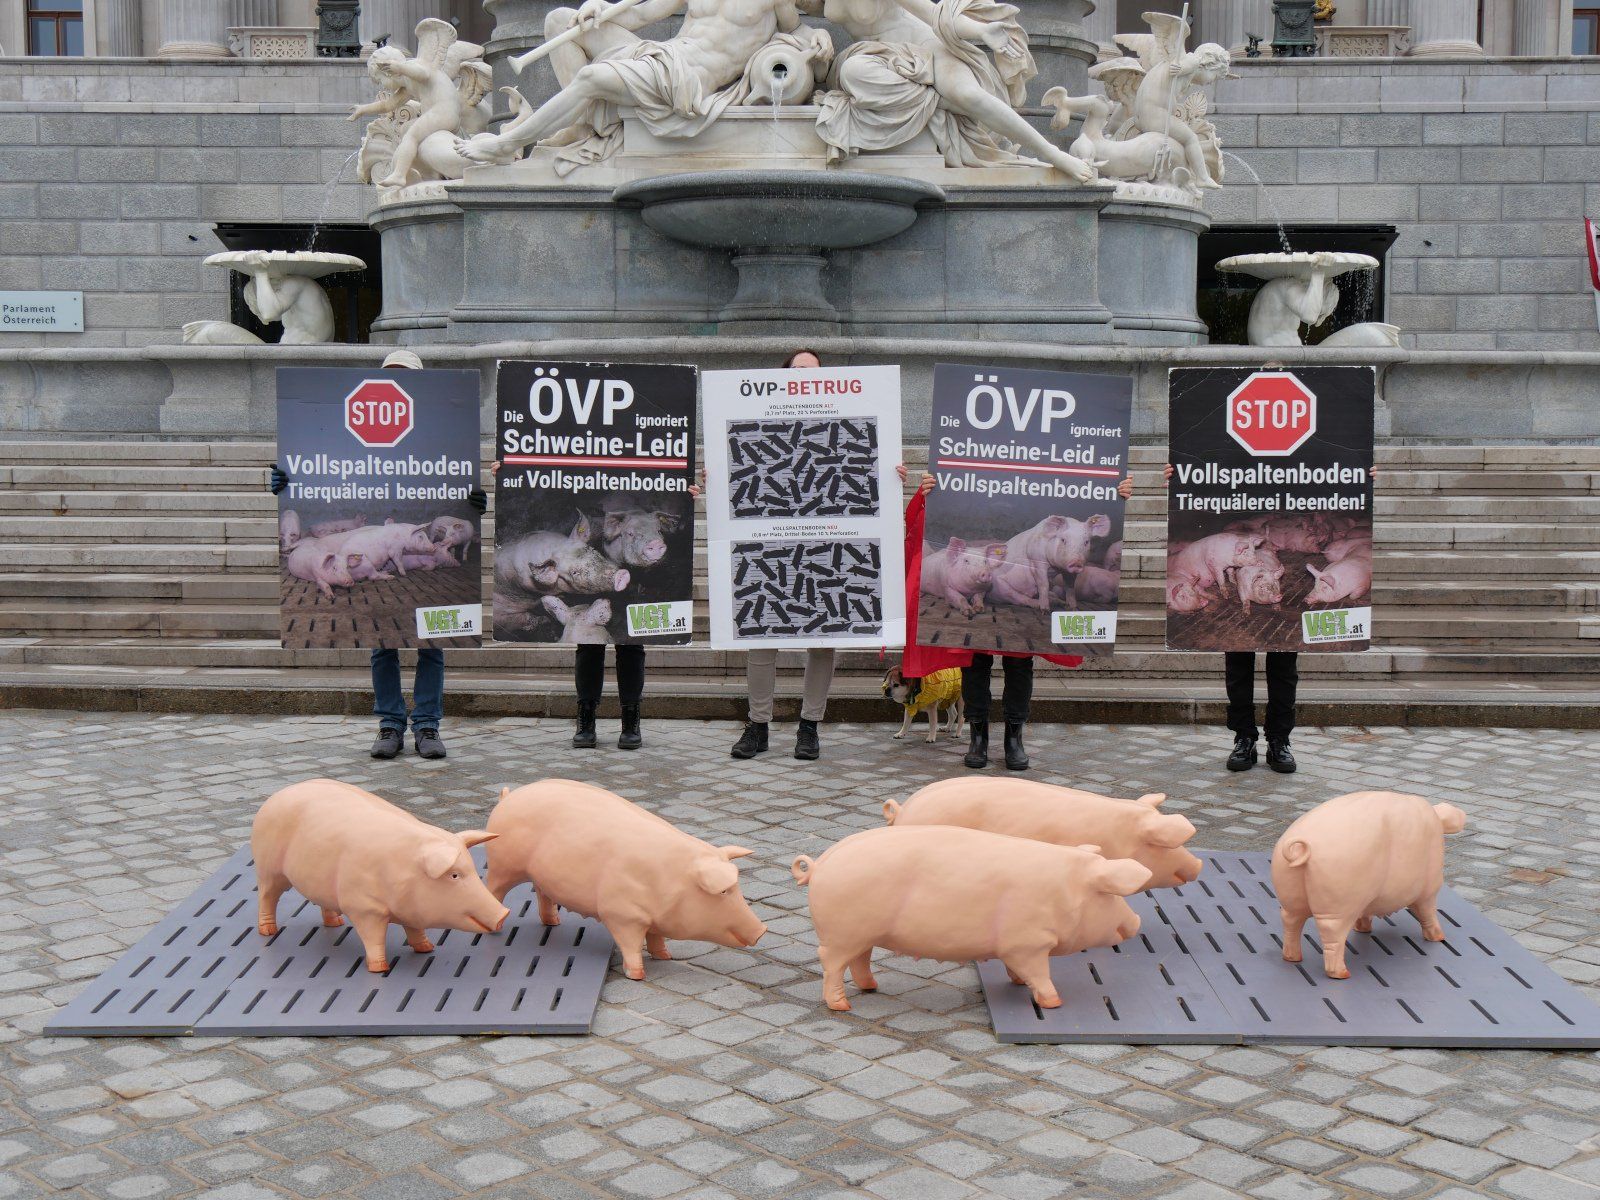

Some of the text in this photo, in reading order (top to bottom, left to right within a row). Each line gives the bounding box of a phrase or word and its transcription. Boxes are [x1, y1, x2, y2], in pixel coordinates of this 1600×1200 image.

[3, 304, 56, 313] Parlament
[3, 315, 56, 324] Österreich
[503, 367, 689, 429] Die ÖVP ignoriert
[739, 379, 863, 397] ÖVP-BETRUG
[352, 401, 407, 426] STOP
[940, 374, 1122, 438] Die ÖVP ignoriert
[1236, 399, 1307, 429] STOP
[503, 428, 688, 457] Schweine-Leid
[938, 437, 1121, 466] Schweine-Leid auf
[286, 453, 473, 480] Vollspaltenboden
[1176, 462, 1365, 489] Vollspaltenboden
[287, 482, 473, 504] Tierquälerei beenden!
[503, 469, 687, 494] auf Vollspaltenboden
[936, 472, 1118, 501] Vollspaltenboden
[1175, 493, 1365, 514] Tierquälerei beenden!
